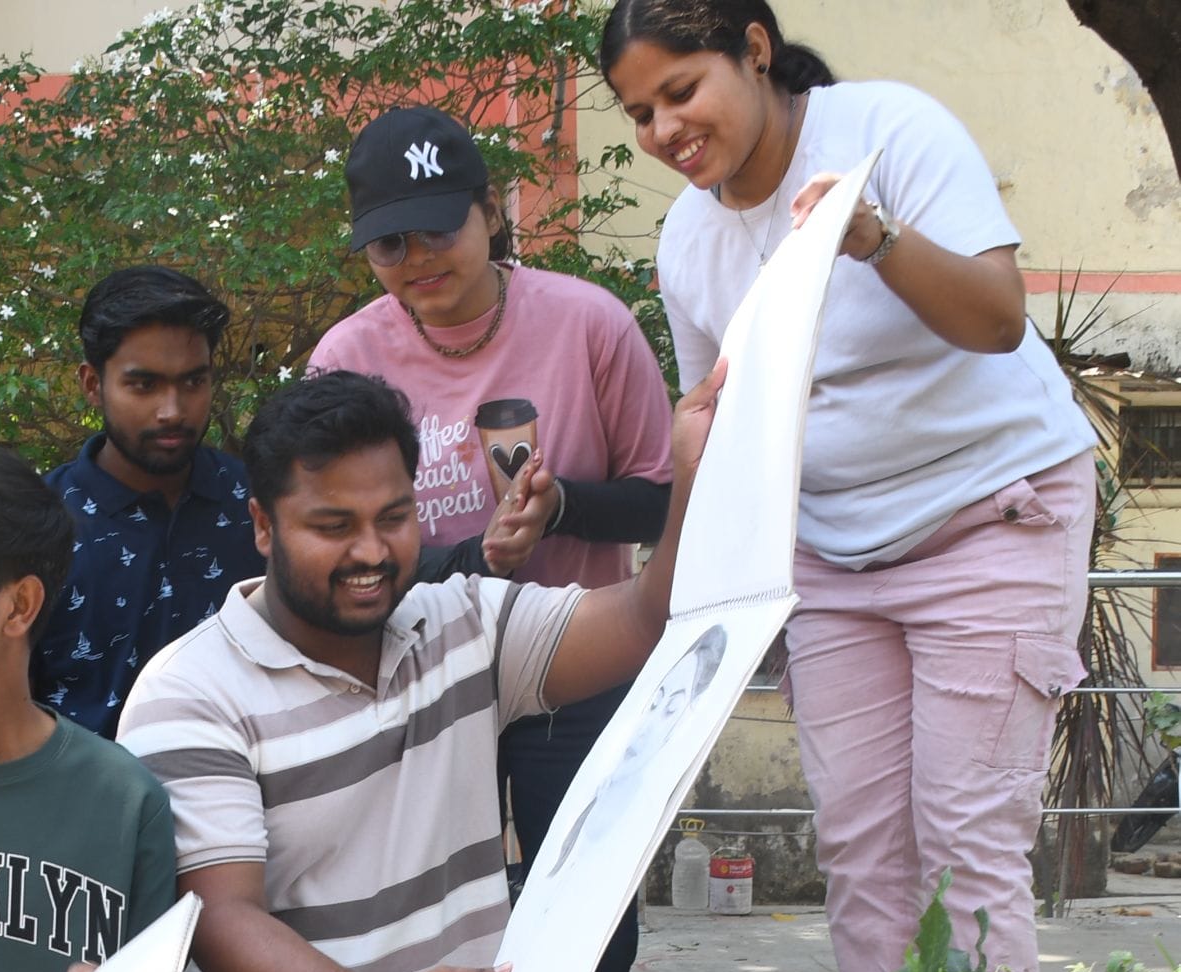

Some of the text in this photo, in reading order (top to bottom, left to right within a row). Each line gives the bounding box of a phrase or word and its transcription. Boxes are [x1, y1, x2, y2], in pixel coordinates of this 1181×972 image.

[404, 141, 444, 180] NY
[416, 414, 470, 468] ffee
[413, 451, 471, 491] each
[416, 479, 486, 536] epeat
